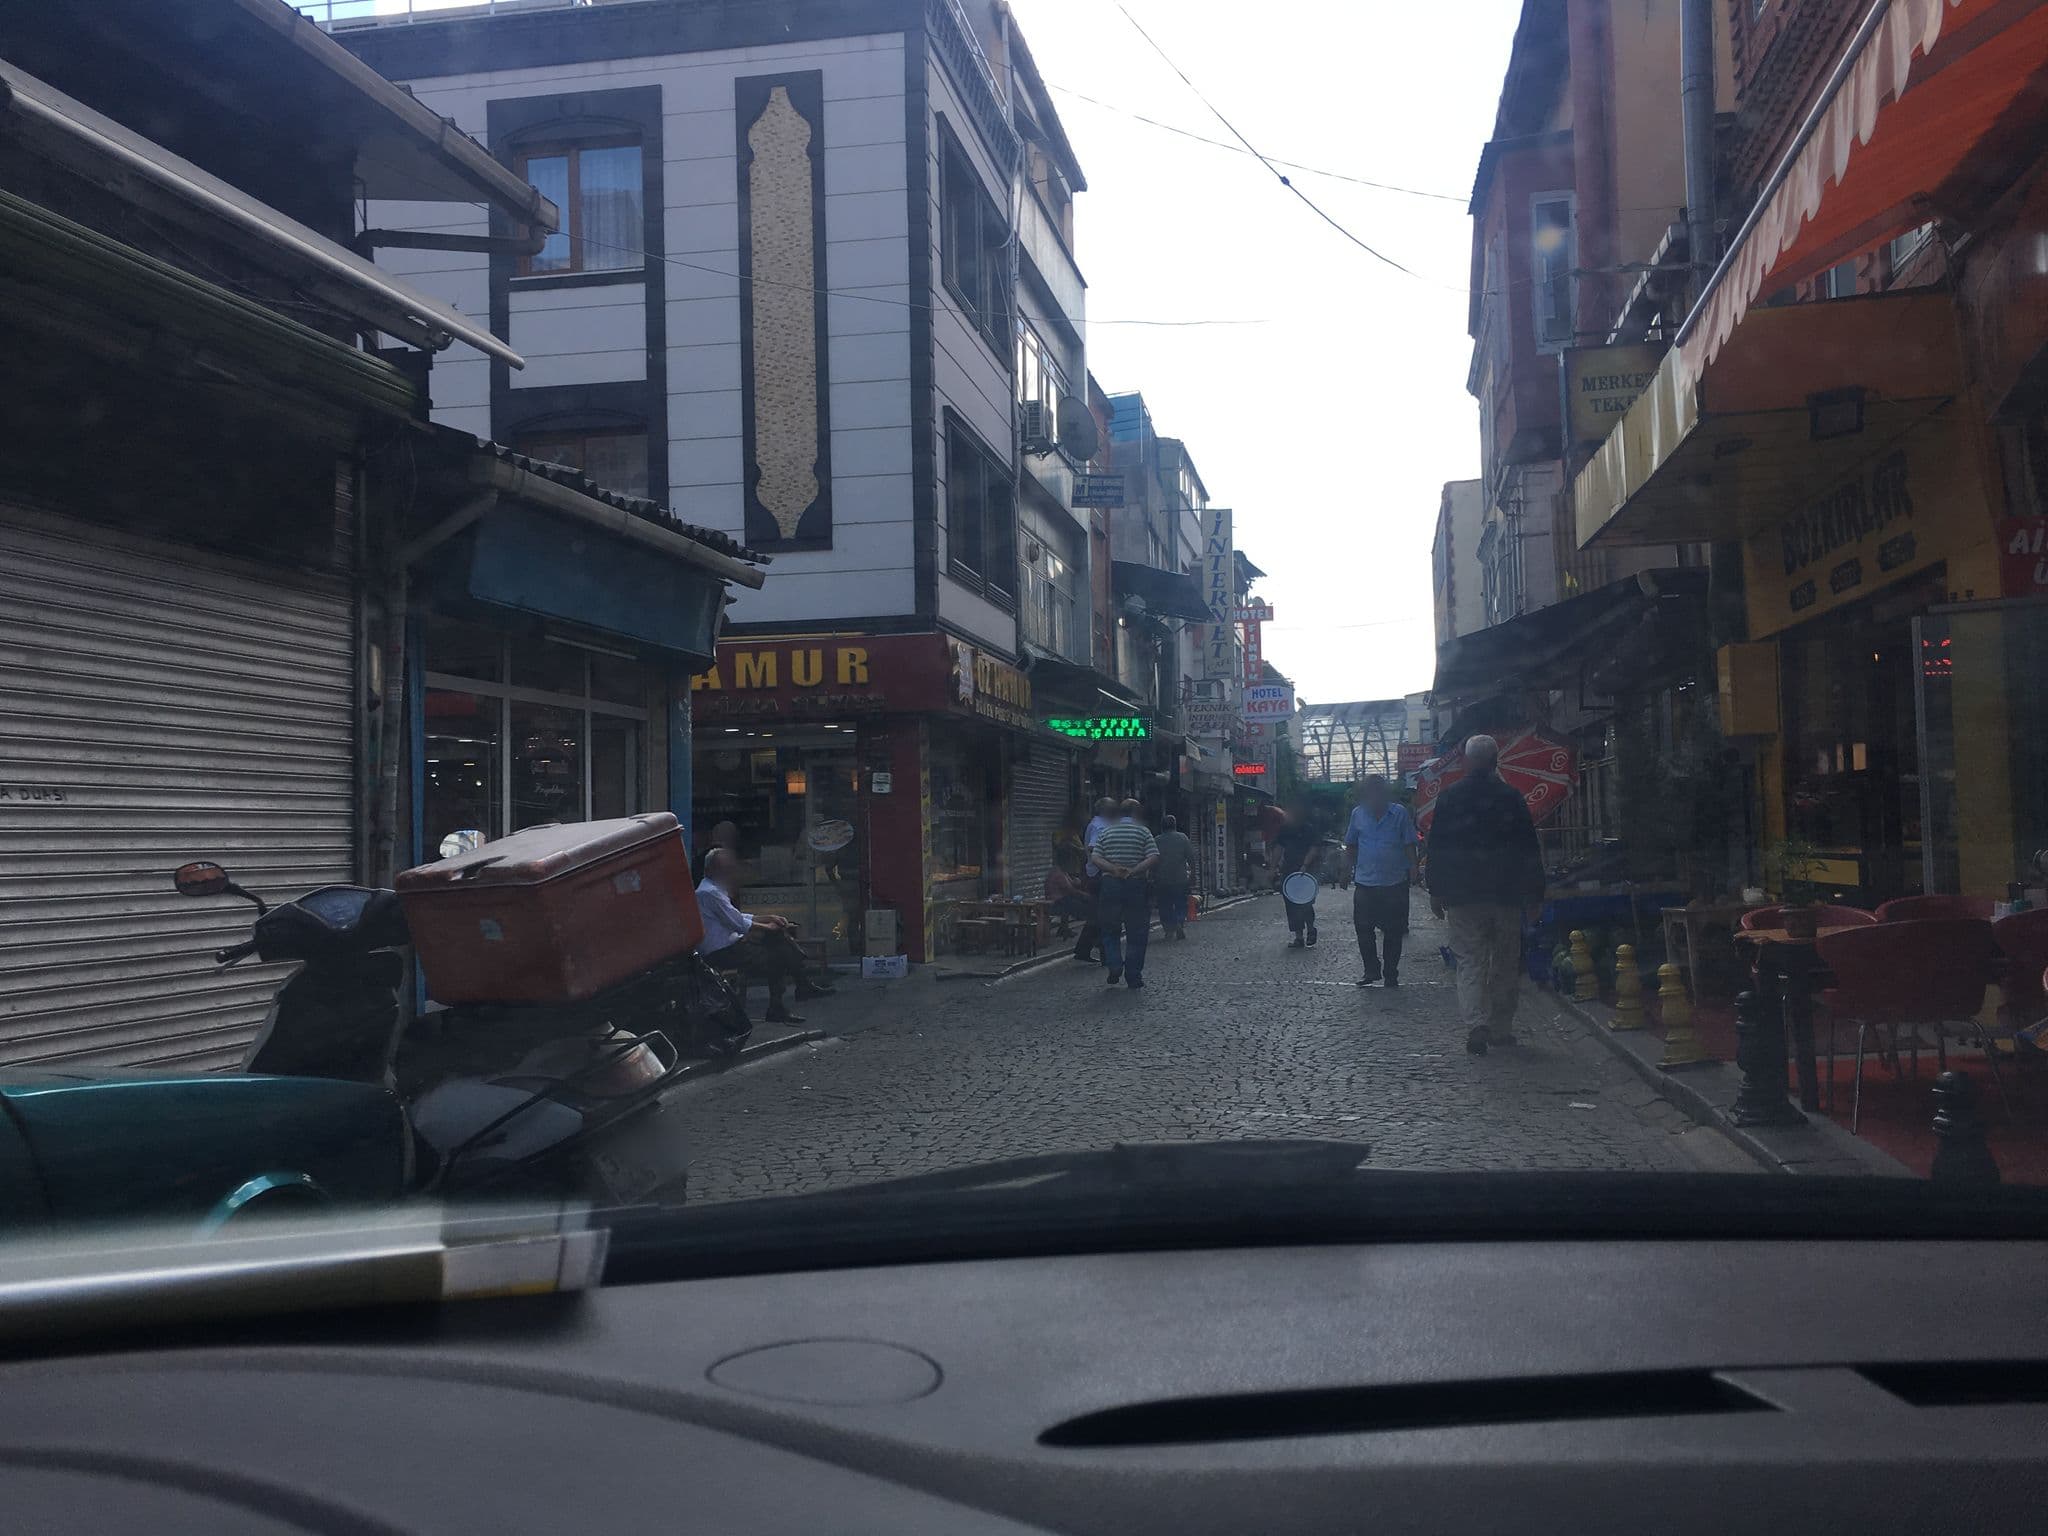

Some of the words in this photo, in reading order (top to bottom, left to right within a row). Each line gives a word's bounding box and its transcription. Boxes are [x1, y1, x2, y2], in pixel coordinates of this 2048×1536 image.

[1233, 609, 1272, 621] HOTEL
[1251, 687, 1284, 700] HOTEL
[1246, 700, 1290, 713] KAYA
[1100, 718, 1141, 730] SPOR
